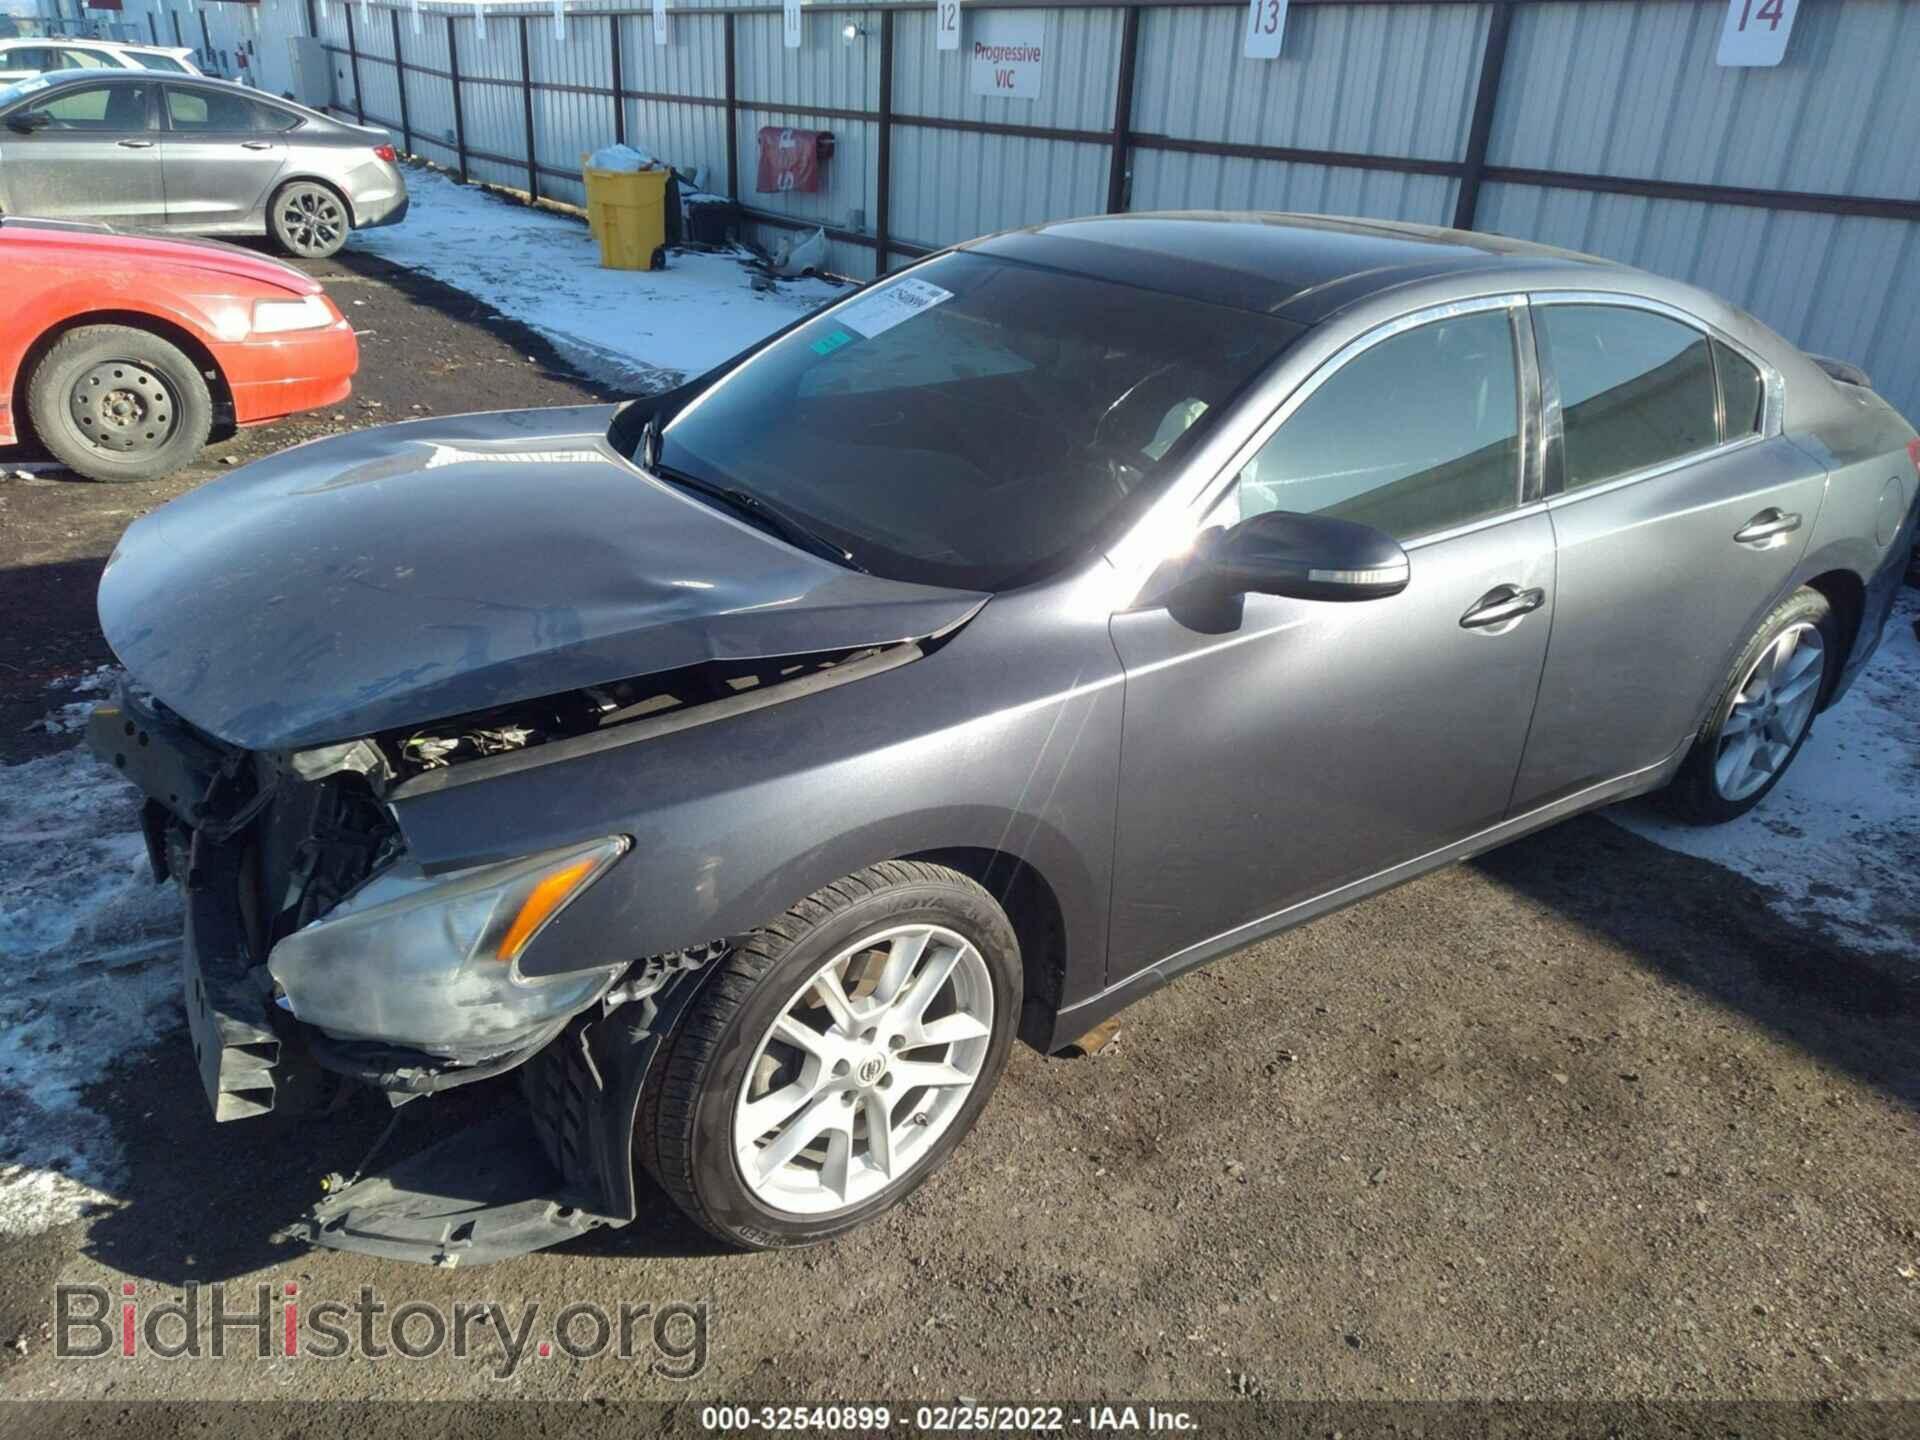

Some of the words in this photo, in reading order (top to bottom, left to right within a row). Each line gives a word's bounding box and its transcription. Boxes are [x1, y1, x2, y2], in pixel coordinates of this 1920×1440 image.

[940, 2, 957, 31] 12
[1254, 0, 1280, 34] 13
[1738, 0, 1783, 31] 14
[974, 41, 1041, 64] Progressive
[995, 68, 1015, 88] VIC
